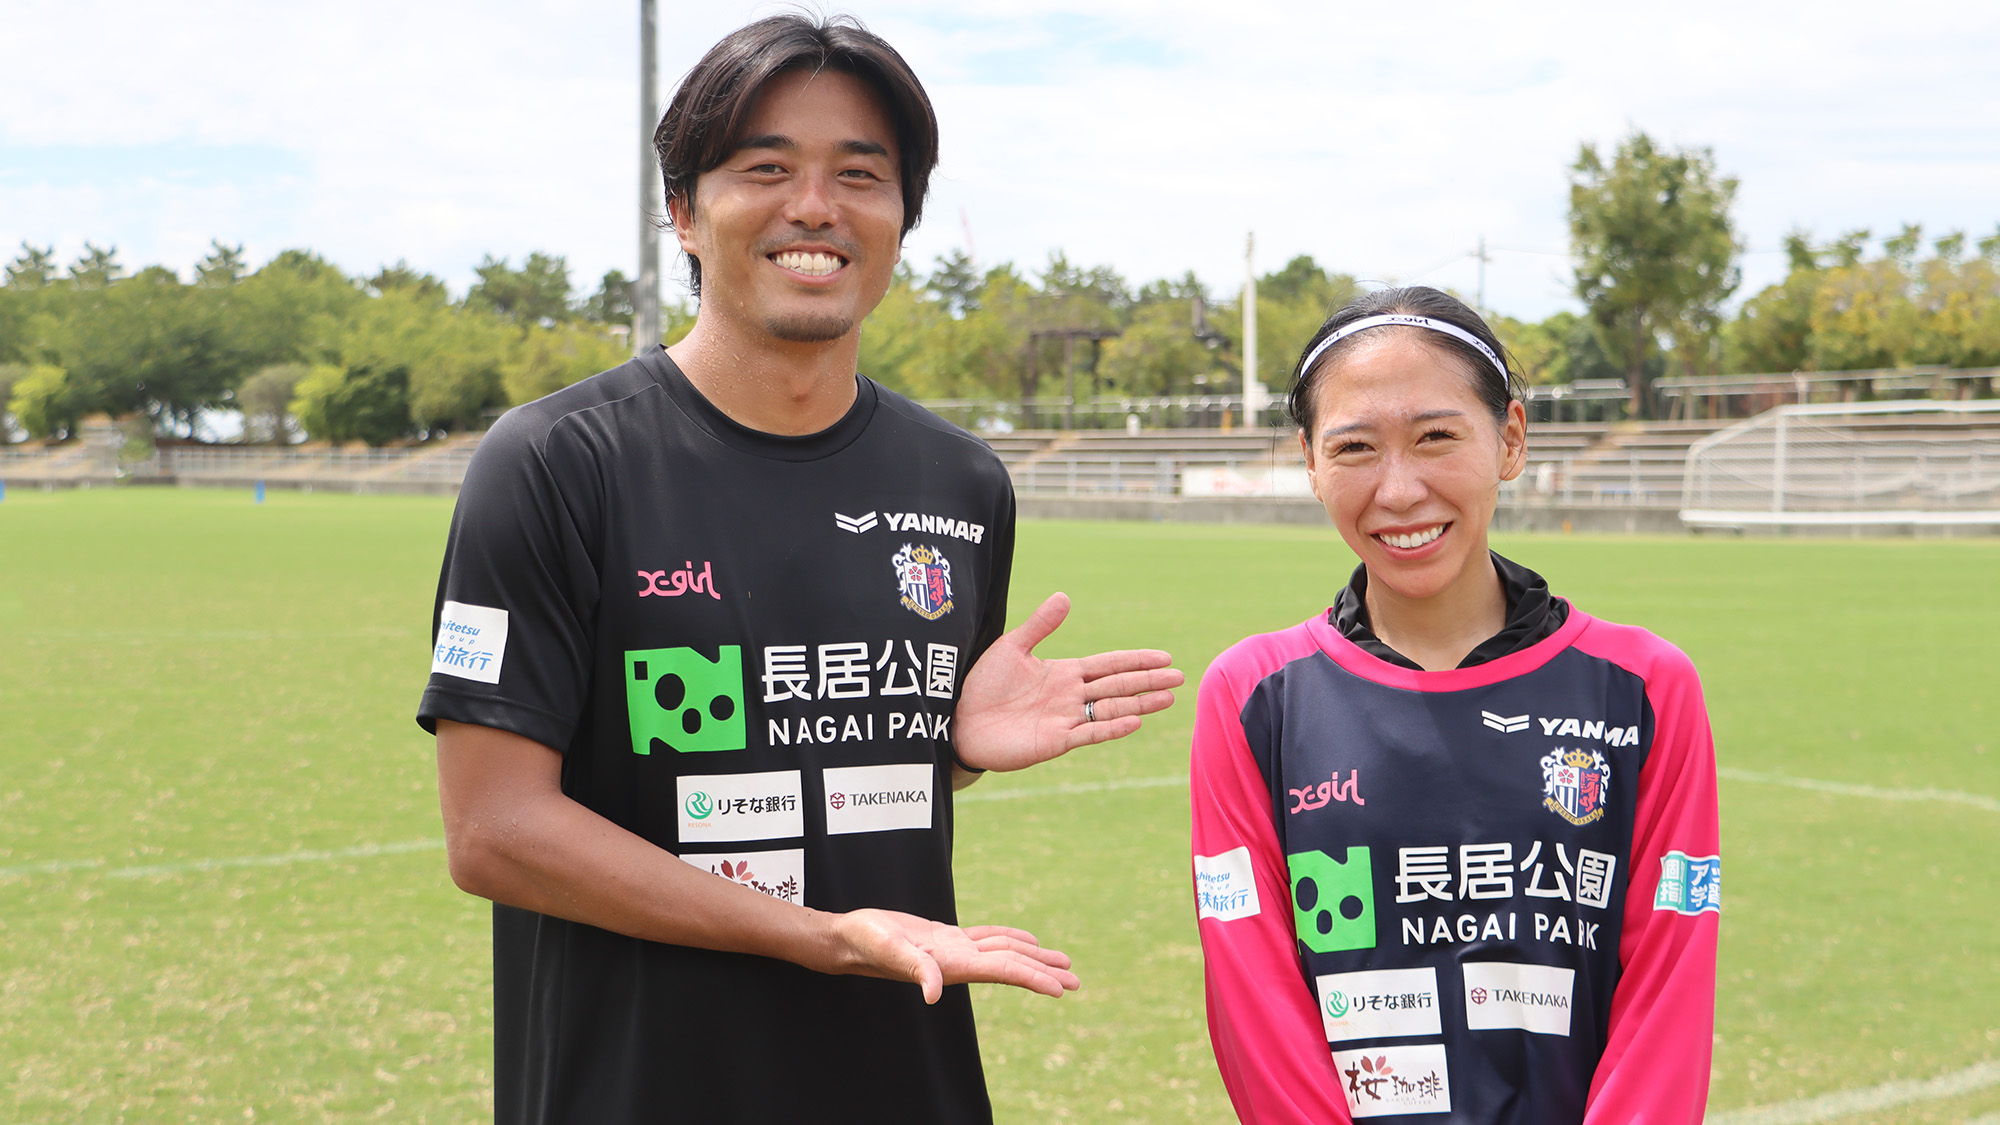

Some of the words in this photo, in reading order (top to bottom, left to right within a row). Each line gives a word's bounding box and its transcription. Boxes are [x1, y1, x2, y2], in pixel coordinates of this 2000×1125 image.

[883, 513, 985, 544] YANMAR
[761, 639, 958, 703] 長居公園
[768, 713, 874, 746] NAGAI
[718, 795, 796, 815] りそな銀行
[849, 790, 928, 806] TAKENAKA
[1395, 840, 1617, 910] 長居公園
[1402, 912, 1517, 946] NAGAI
[1354, 992, 1432, 1012] りそな銀行
[1492, 989, 1569, 1010] TAKENAKA
